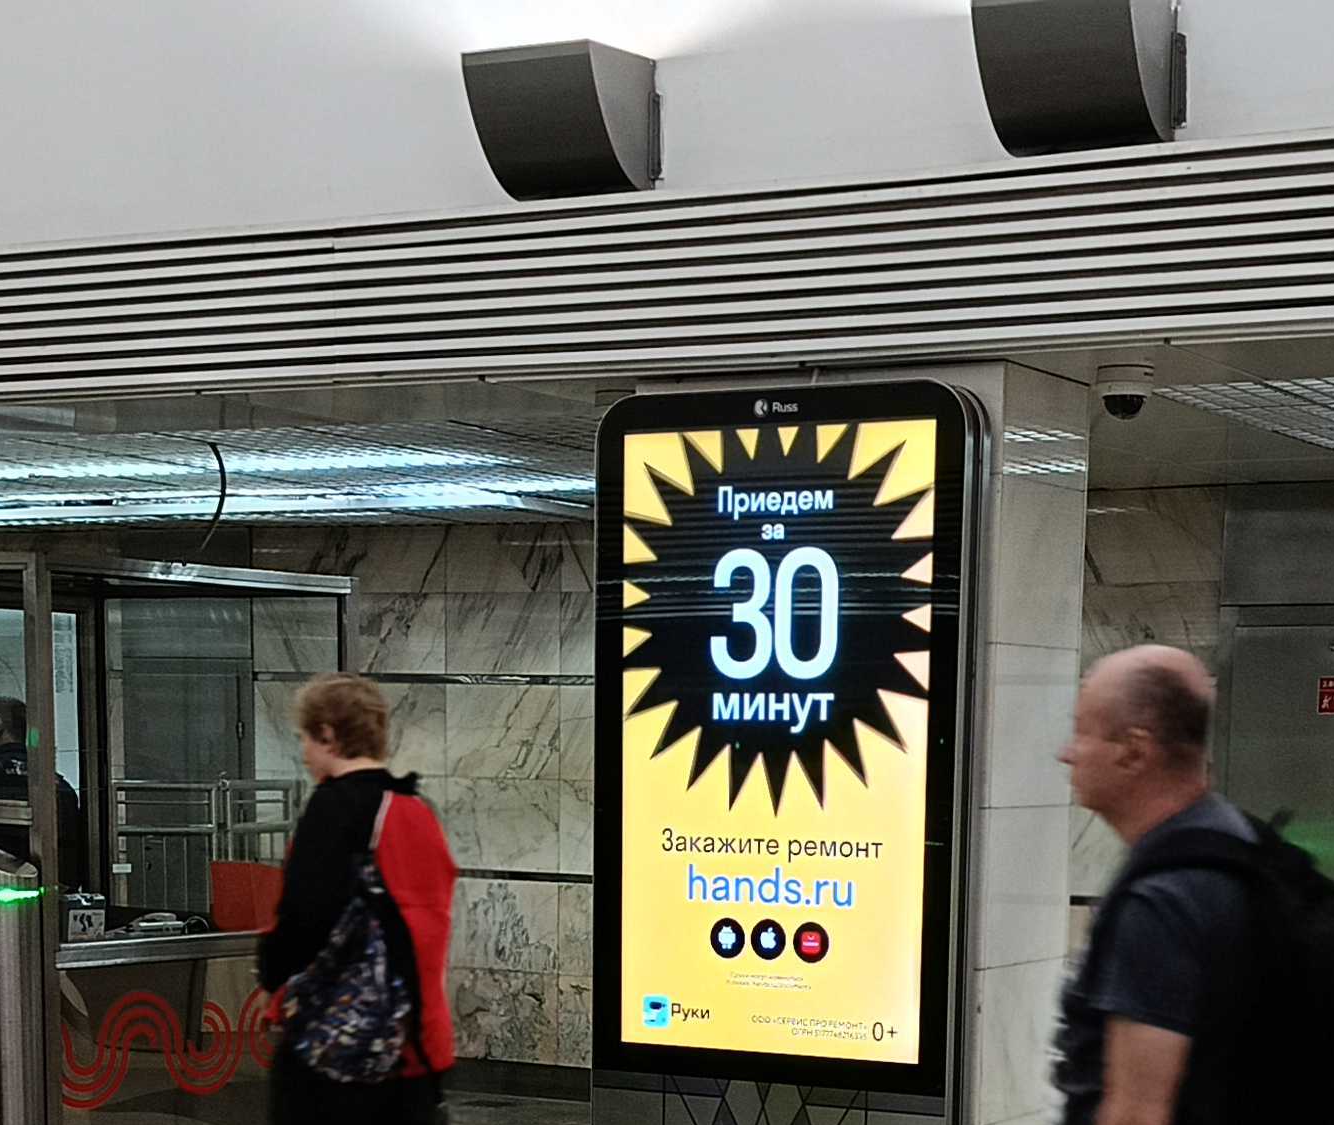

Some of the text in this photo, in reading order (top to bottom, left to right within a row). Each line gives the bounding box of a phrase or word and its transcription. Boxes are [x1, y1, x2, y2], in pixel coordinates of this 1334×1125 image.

[771, 401, 799, 414] Russ
[717, 485, 835, 521] Приедем
[761, 522, 785, 540] за
[710, 546, 839, 680] 30
[712, 691, 835, 734] минут
[661, 827, 884, 863] Закажите ремонт
[688, 863, 852, 907] hands.ru
[671, 1002, 710, 1022] Руки
[751, 1014, 771, 1024] ООО
[871, 1021, 899, 1042] 0+
